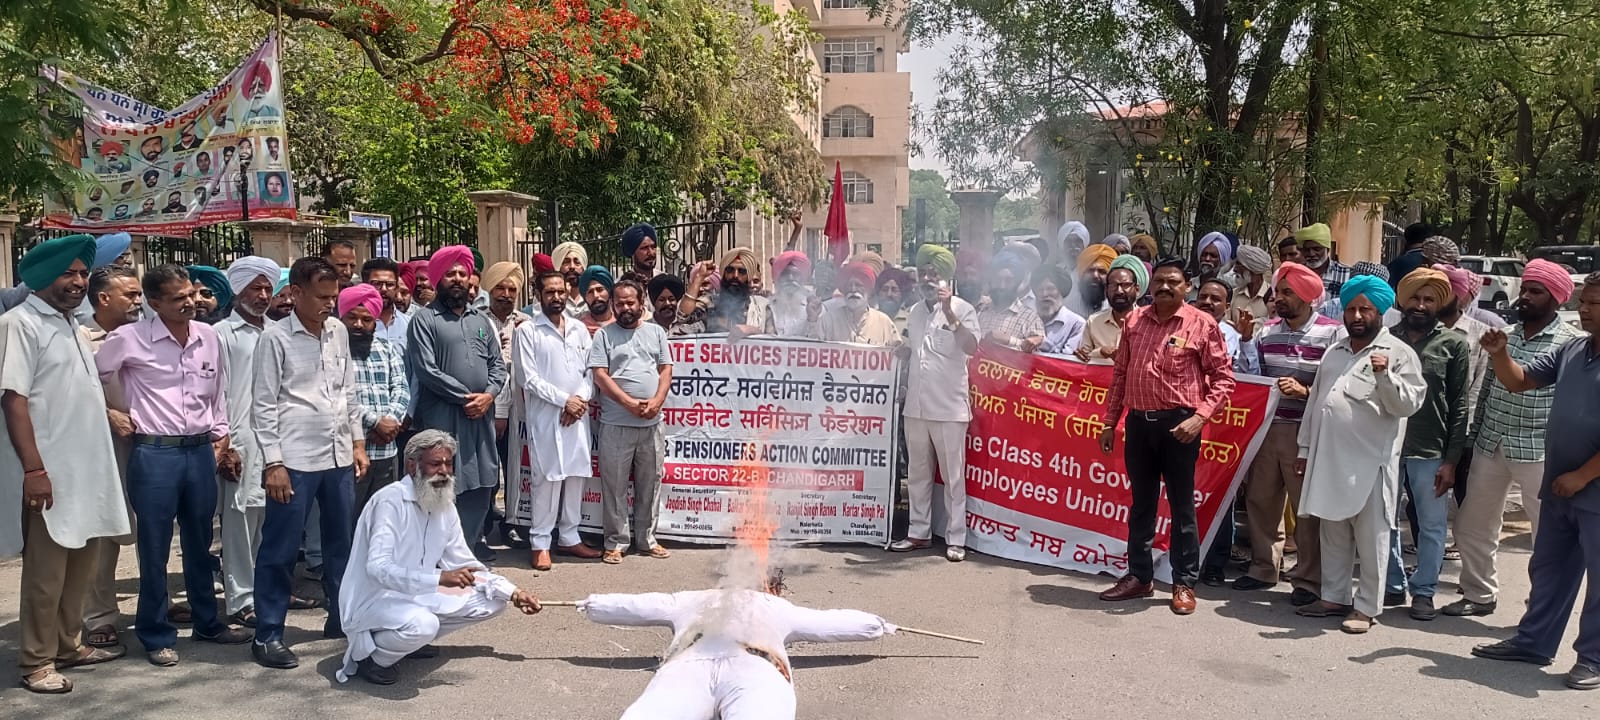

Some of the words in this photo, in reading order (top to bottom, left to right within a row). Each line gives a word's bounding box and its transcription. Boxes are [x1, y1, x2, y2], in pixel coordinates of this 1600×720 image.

[700, 342, 782, 367] SERVICES
[787, 346, 892, 372] FEDERATION
[1013, 396, 1057, 430] ਪੰਜਾਬ
[674, 440, 757, 461] PENSIONERS
[760, 443, 808, 464] ACTION
[811, 446, 887, 468] COMMITTEE
[987, 436, 1043, 469] Class
[1049, 452, 1082, 480] 4th
[673, 466, 728, 482] SECTOR
[767, 469, 855, 488] CHANDIGARH
[966, 463, 1058, 505] mployees
[1065, 486, 1129, 524] Union
[860, 502, 876, 521] Singh
